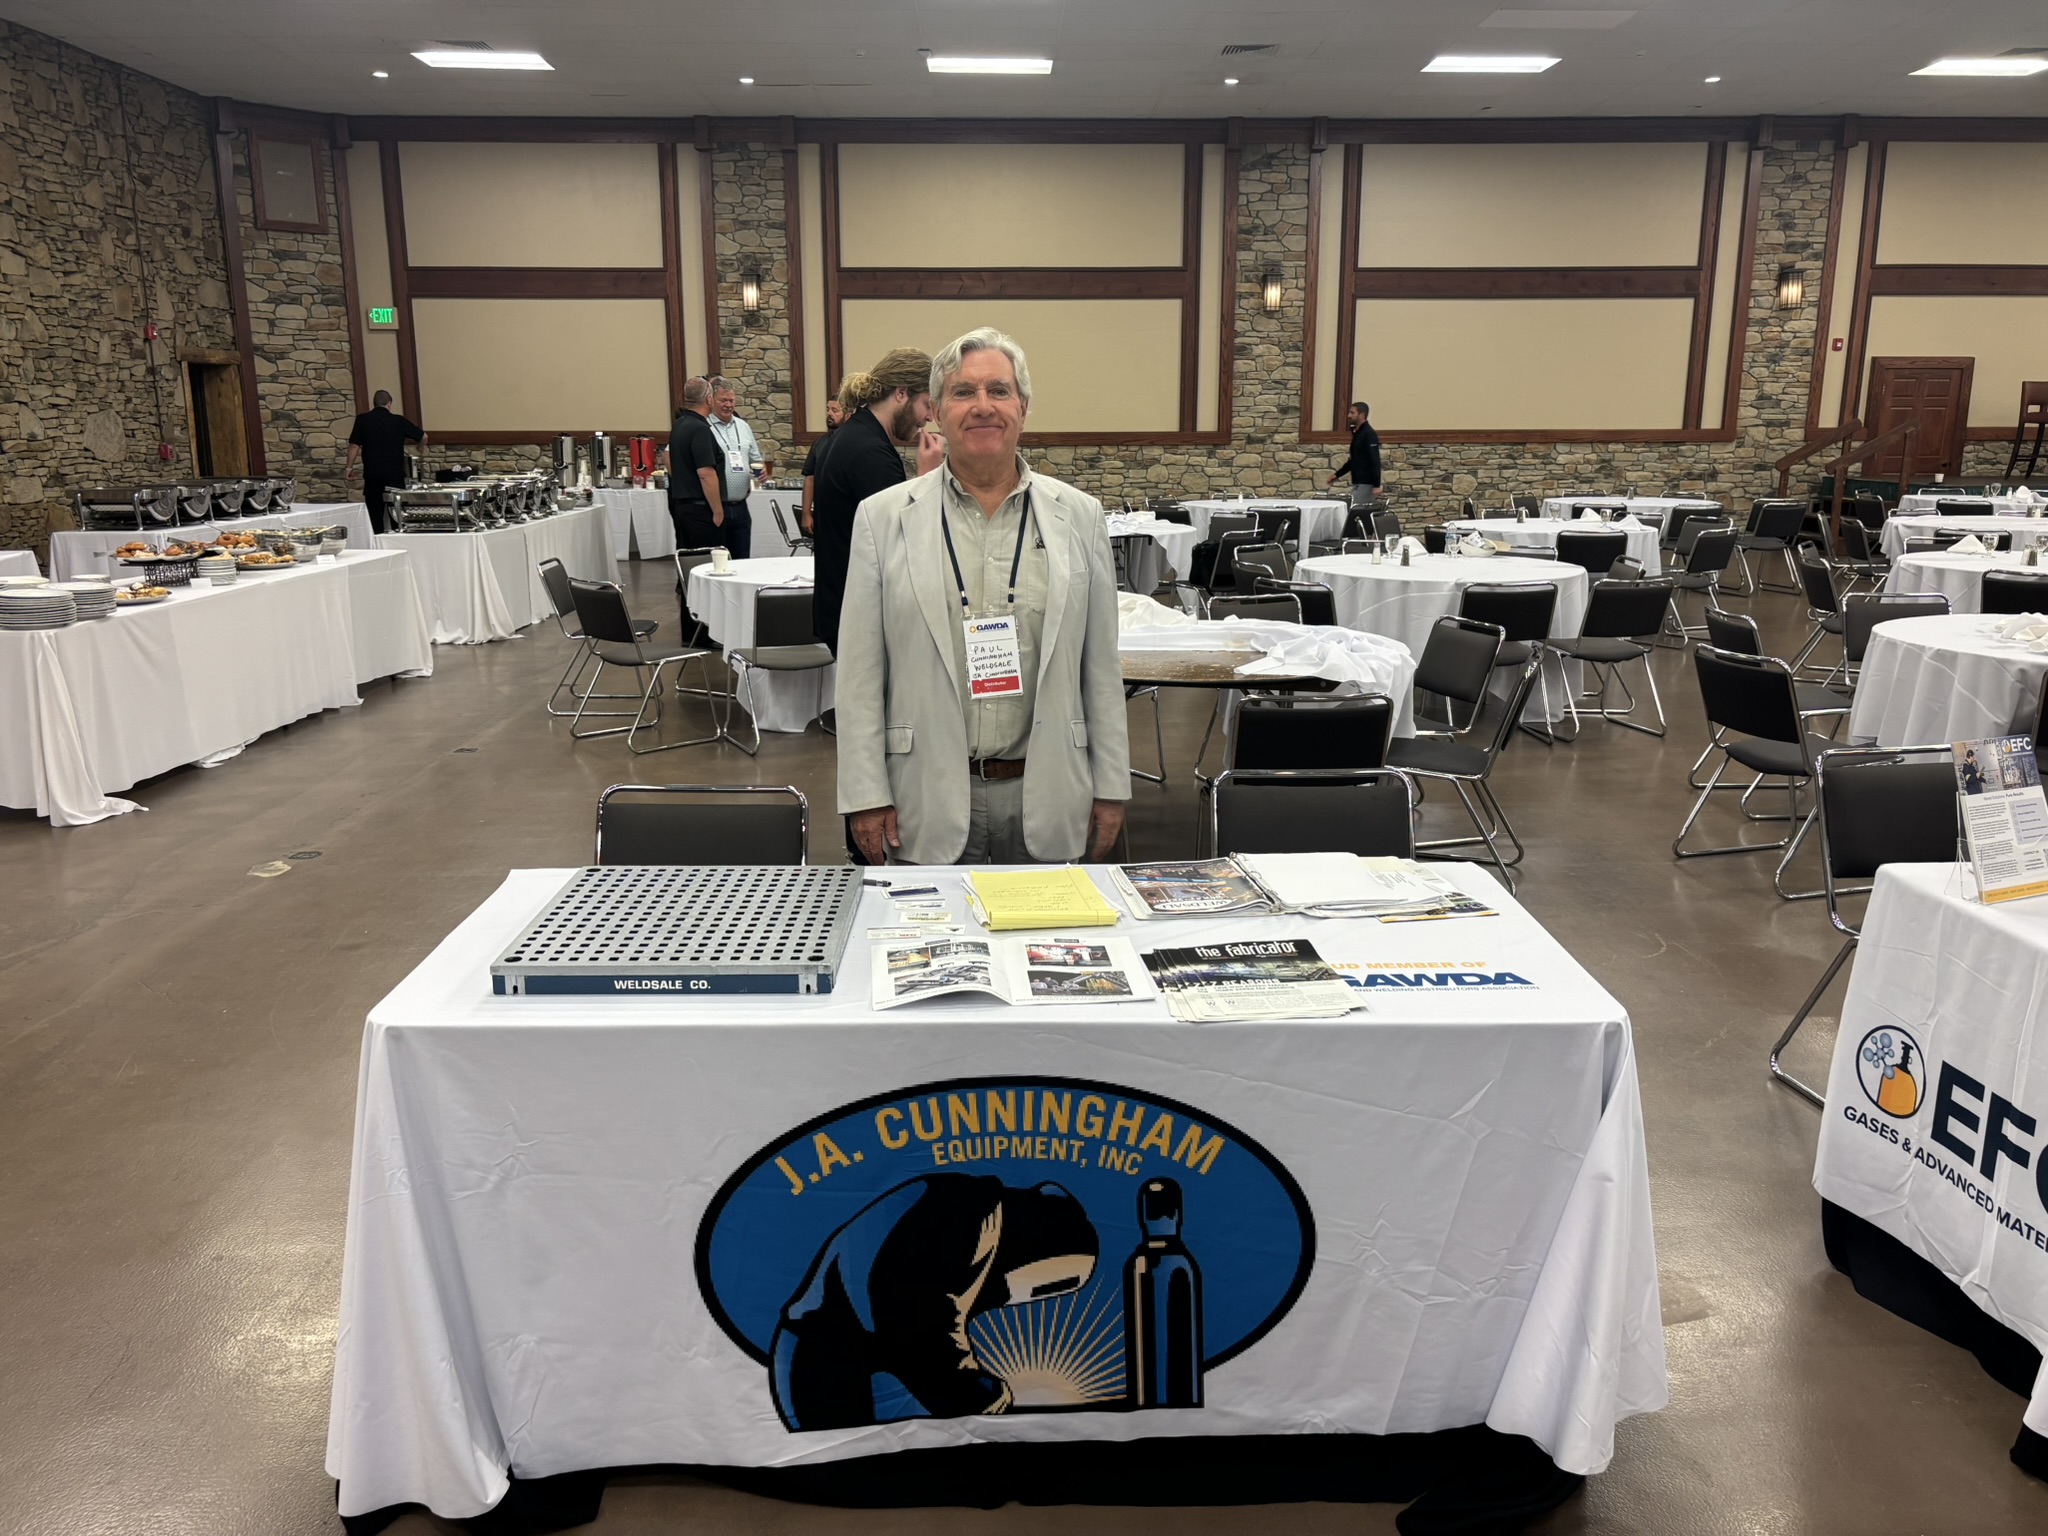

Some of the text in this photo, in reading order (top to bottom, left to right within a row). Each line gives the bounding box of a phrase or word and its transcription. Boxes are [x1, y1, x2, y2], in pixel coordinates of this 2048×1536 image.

[372, 308, 393, 324] EXIT
[976, 622, 1009, 632] GAWDA
[973, 645, 1003, 655] PAUL
[2010, 737, 2032, 752] EFC
[1195, 941, 1297, 958] the fabricator
[1366, 961, 1455, 970] MEMBER
[1459, 961, 1488, 969] OF
[613, 979, 711, 990] WELDSALE CO.
[775, 1089, 1226, 1197] J.A. CUNNINGHAM
[1930, 1060, 2048, 1214] EF
[932, 1136, 1144, 1177] EQUIPMENT, INC
[1843, 1105, 1899, 1145] GASES
[1901, 1137, 1912, 1154] &
[1914, 1147, 1994, 1214] ADVANCED
